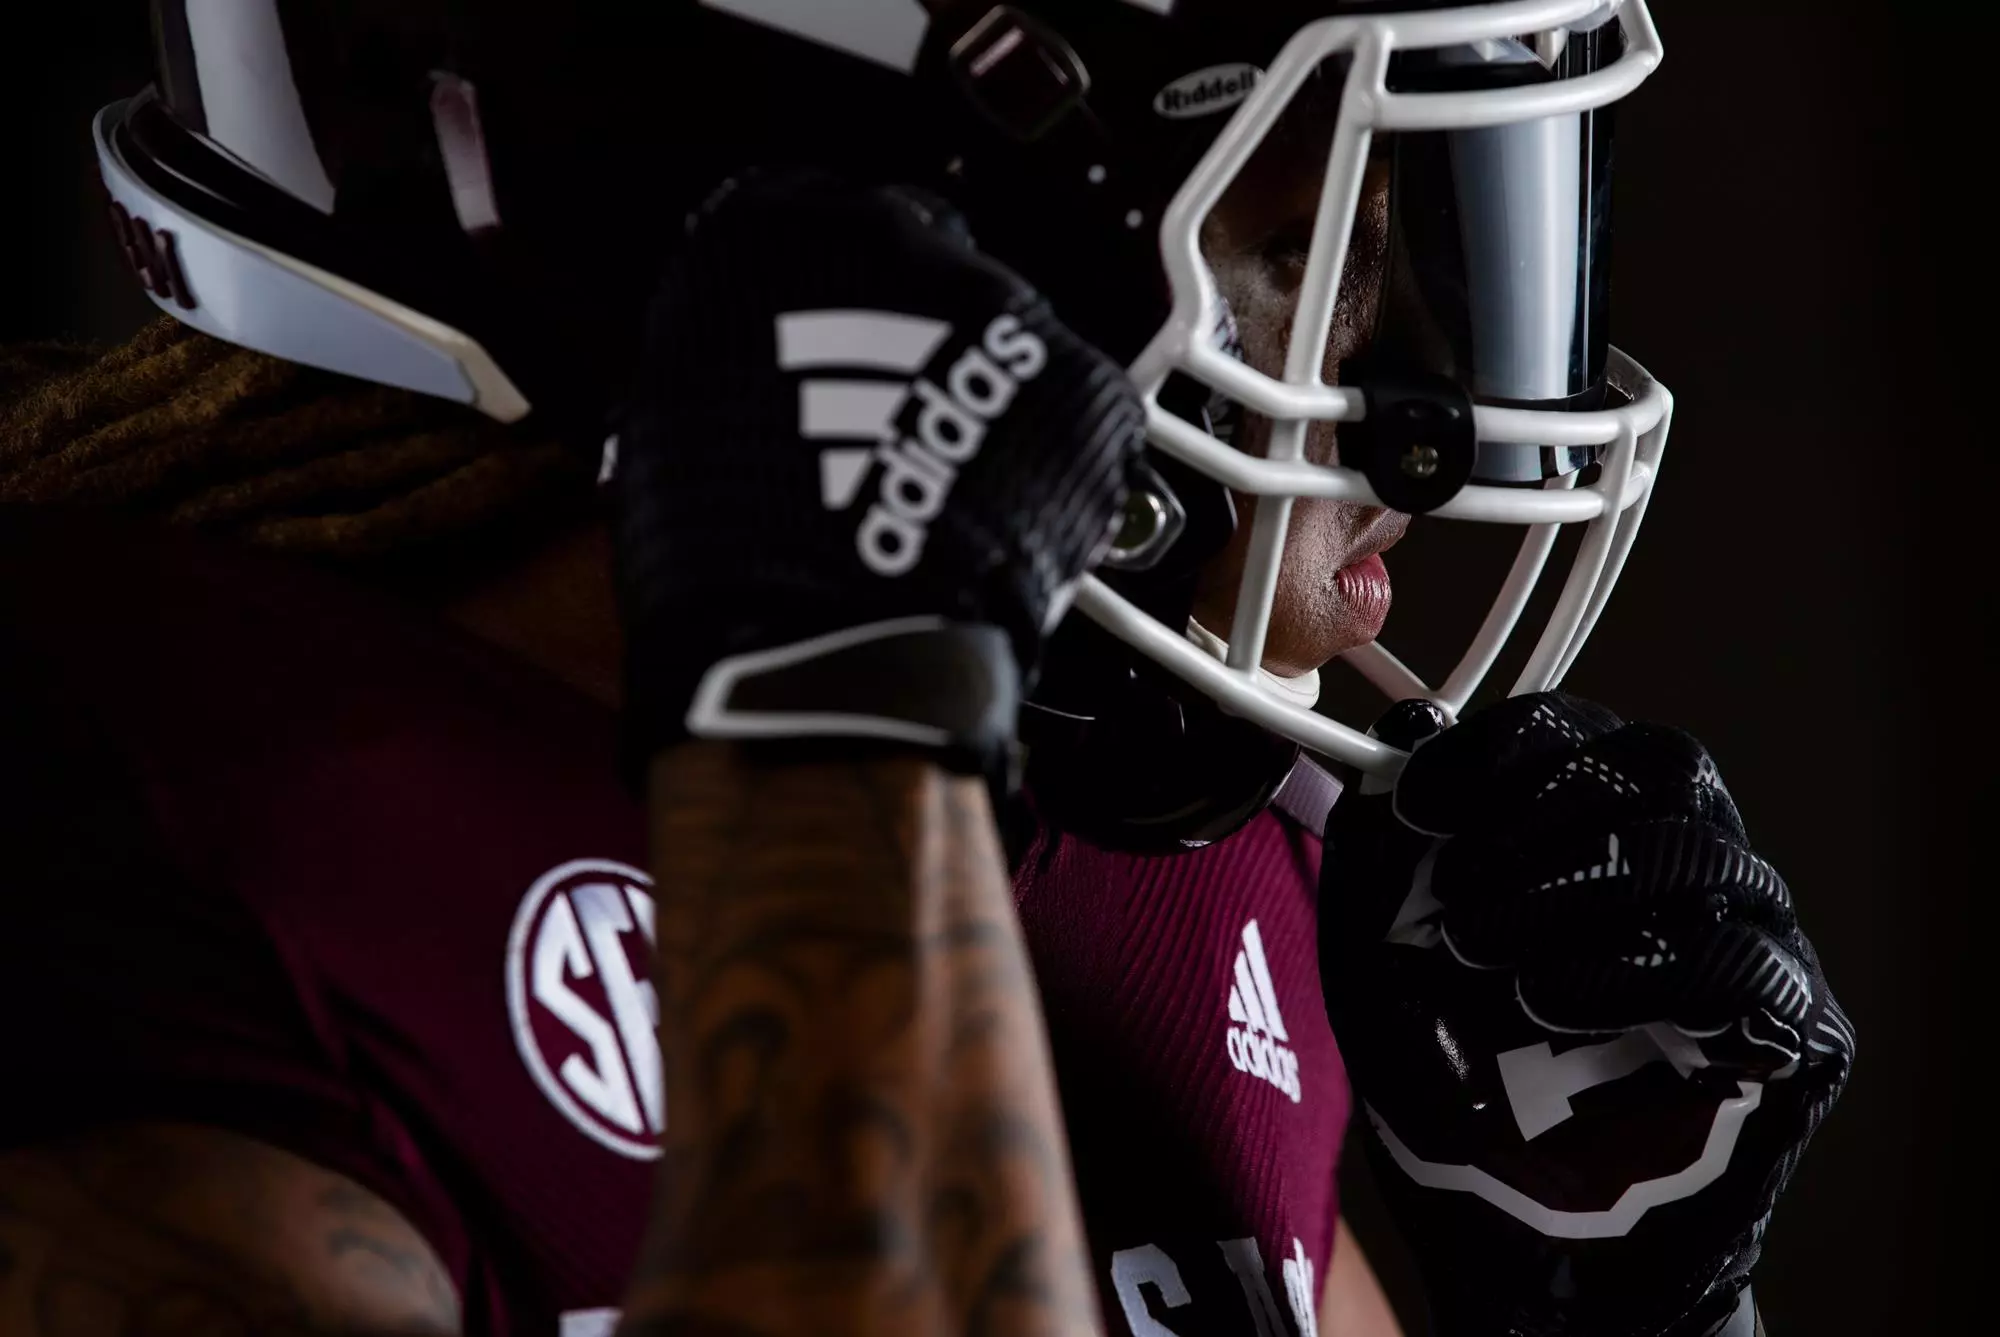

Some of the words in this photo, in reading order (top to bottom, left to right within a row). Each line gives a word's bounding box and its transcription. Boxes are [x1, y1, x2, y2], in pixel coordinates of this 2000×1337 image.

[1164, 68, 1255, 111] Riddell
[855, 313, 1048, 577] adidas
[531, 882, 667, 1136] SE
[1226, 1021, 1302, 1104] adidas
